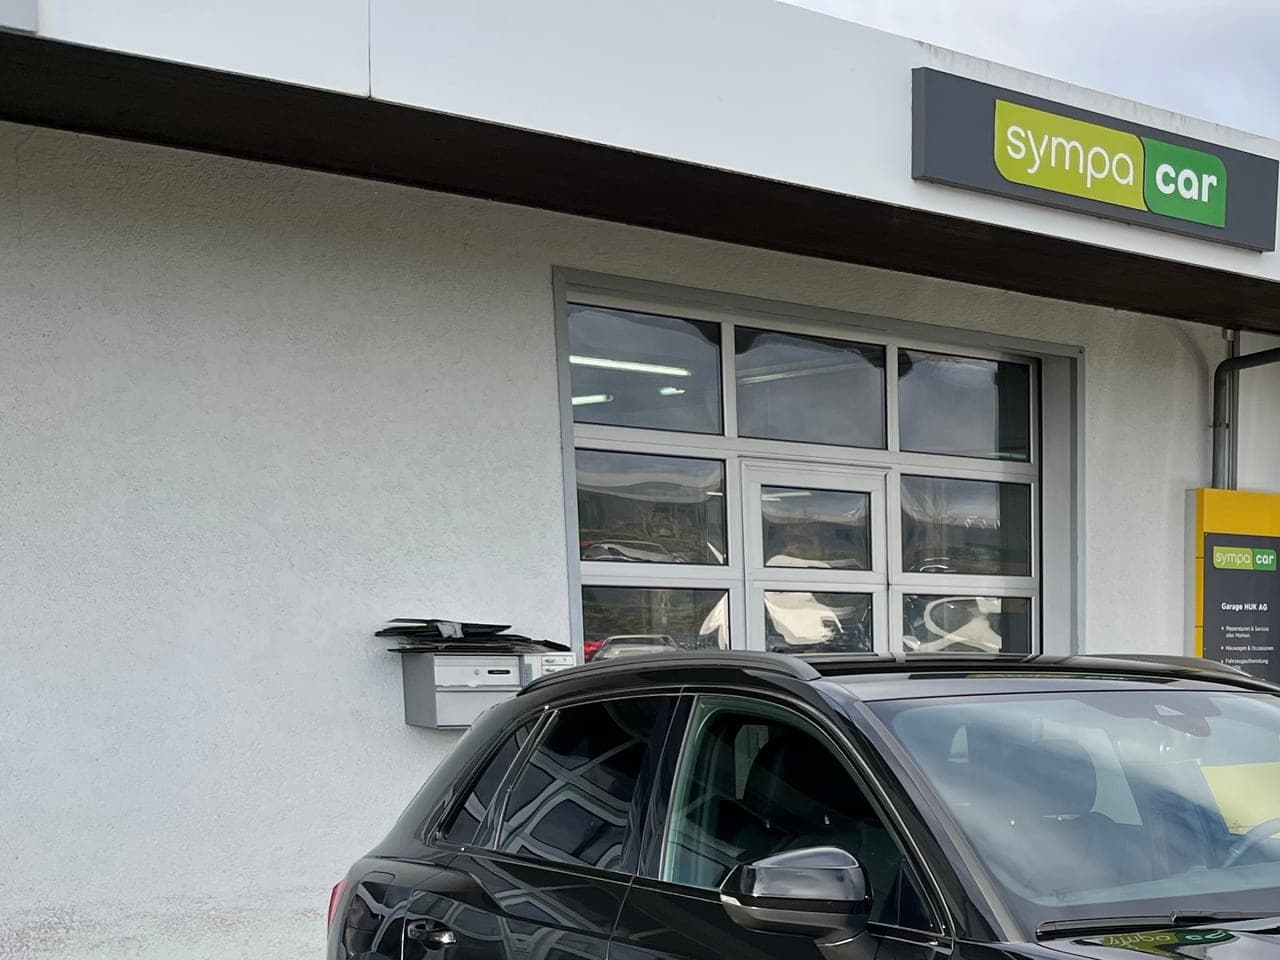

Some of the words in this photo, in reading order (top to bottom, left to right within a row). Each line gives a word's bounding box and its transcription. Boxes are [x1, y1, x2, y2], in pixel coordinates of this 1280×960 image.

[1006, 125, 1134, 188] sympa
[1155, 162, 1218, 203] car
[1215, 552, 1250, 566] sympa
[1255, 554, 1275, 565] car
[1221, 602, 1243, 612] Garage
[1243, 602, 1258, 611] HUK
[1258, 603, 1268, 611] AG
